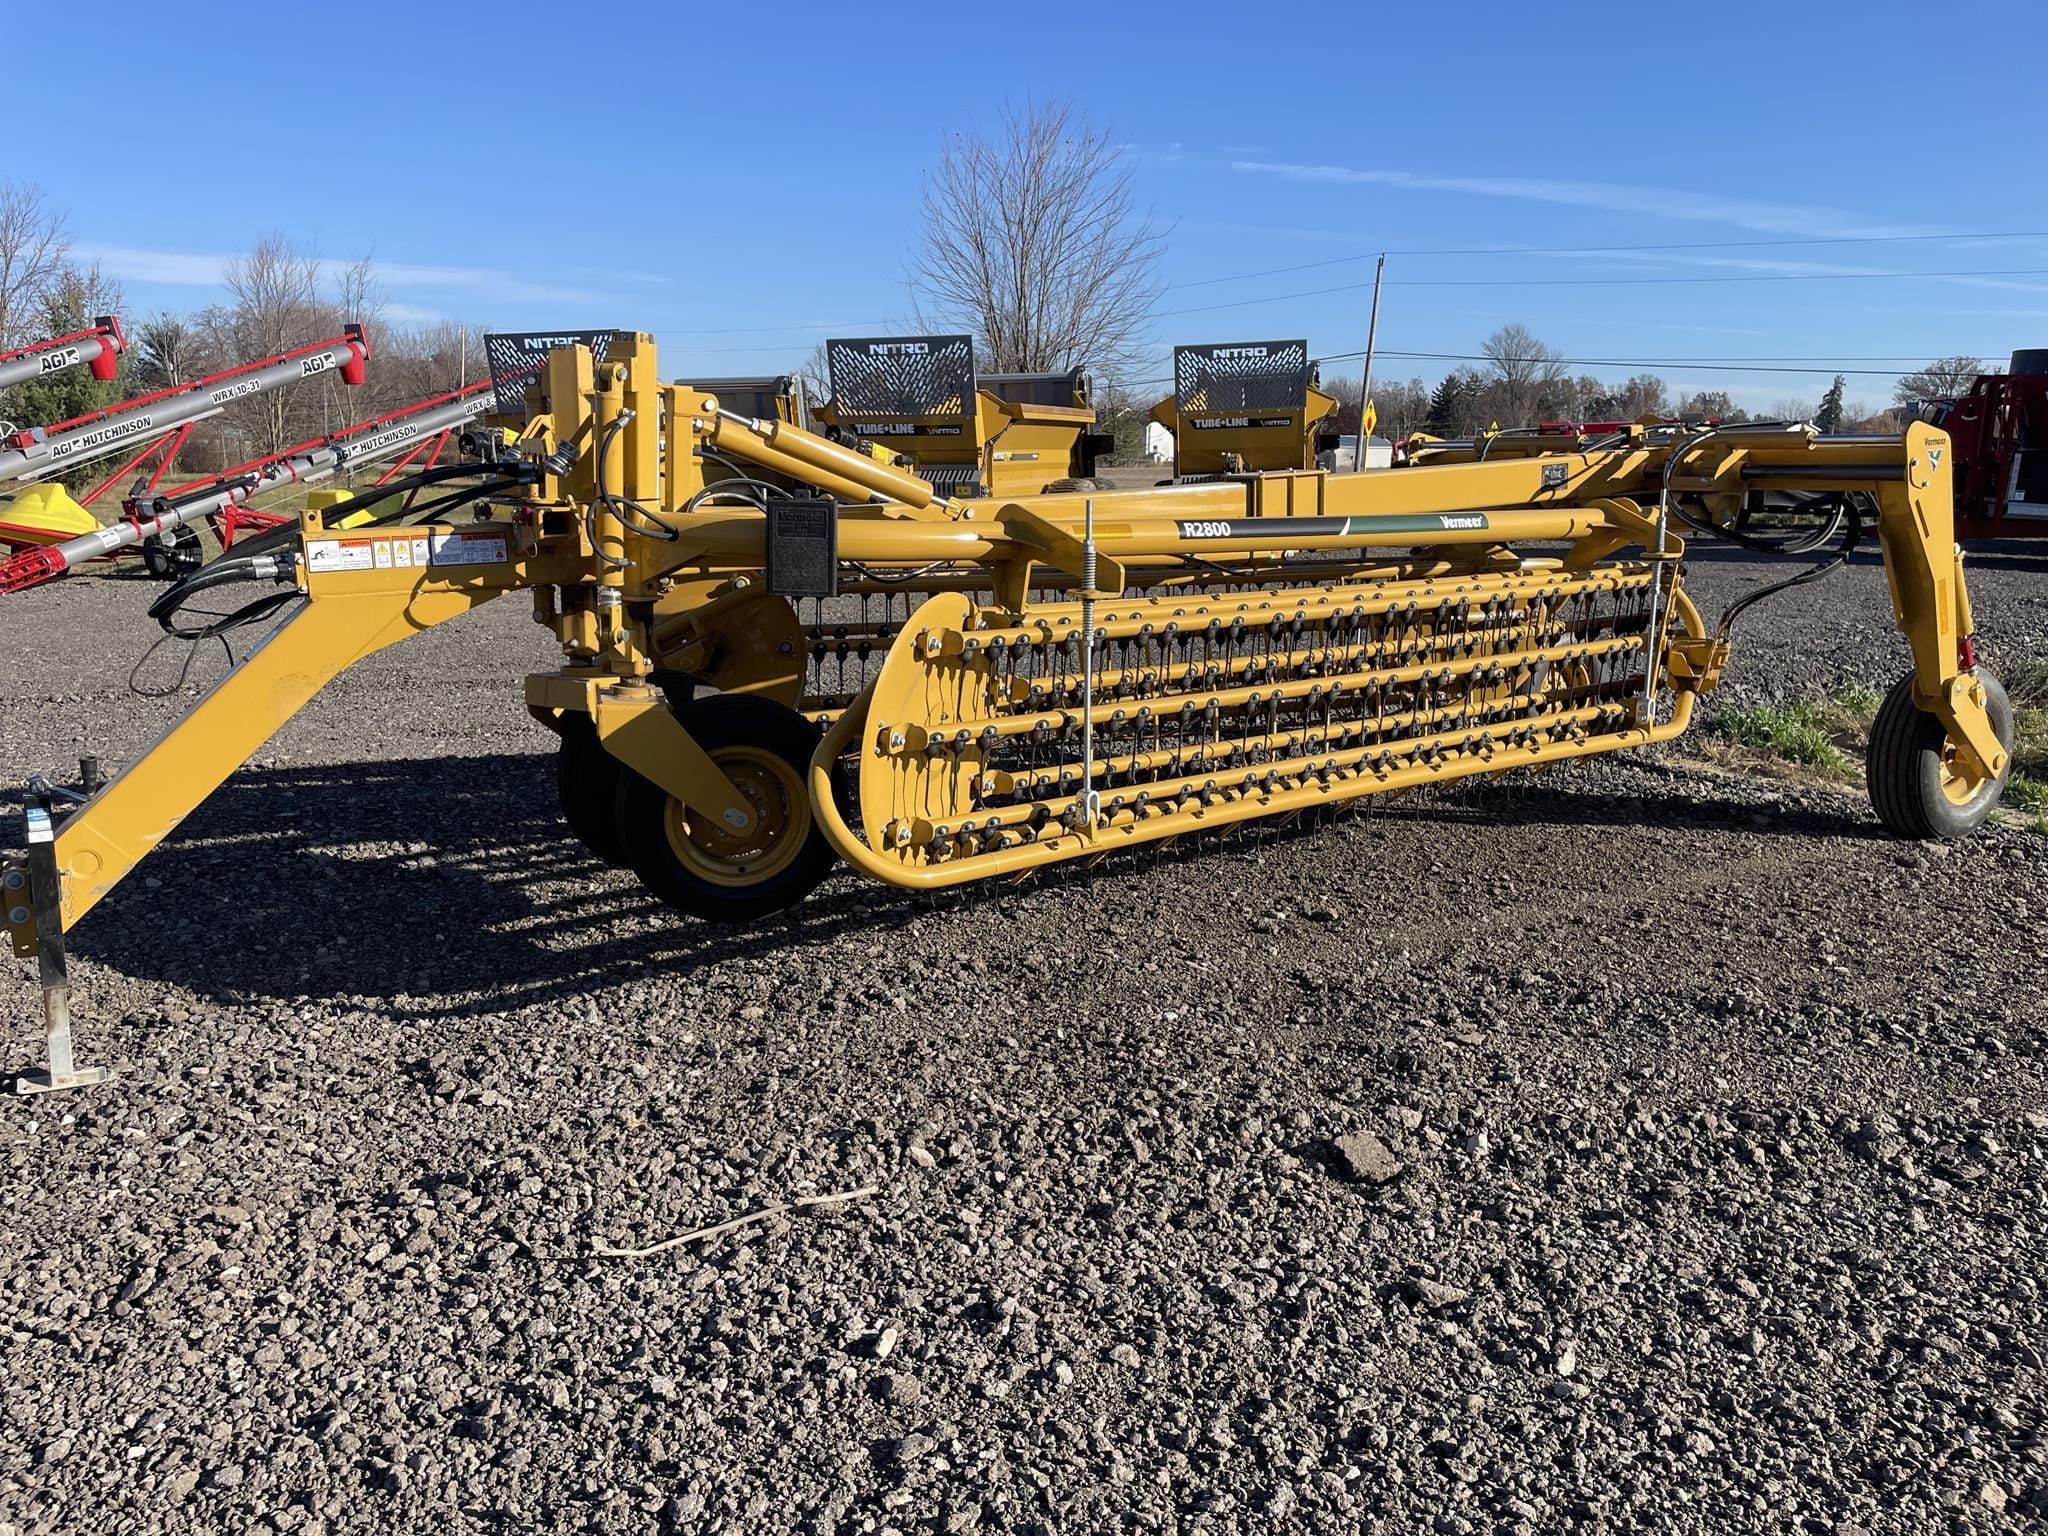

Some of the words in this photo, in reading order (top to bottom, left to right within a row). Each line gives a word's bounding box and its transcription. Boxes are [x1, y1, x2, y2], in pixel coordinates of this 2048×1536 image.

[869, 343, 929, 355] NITRO
[1213, 347, 1267, 359] NITRO
[40, 352, 66, 372] AGI
[302, 356, 325, 375] AGI
[212, 388, 235, 402] WRX
[237, 380, 260, 394] 10-31
[465, 400, 484, 414] WRX
[52, 442, 72, 458] AGI
[83, 416, 152, 447] HUTCHINSON
[336, 447, 352, 463] AGI
[360, 424, 417, 452] HUTCHINSON
[1924, 438, 1946, 446] Vermeer
[1183, 522, 1232, 537] R2800
[1440, 515, 1483, 529] Vermeer
